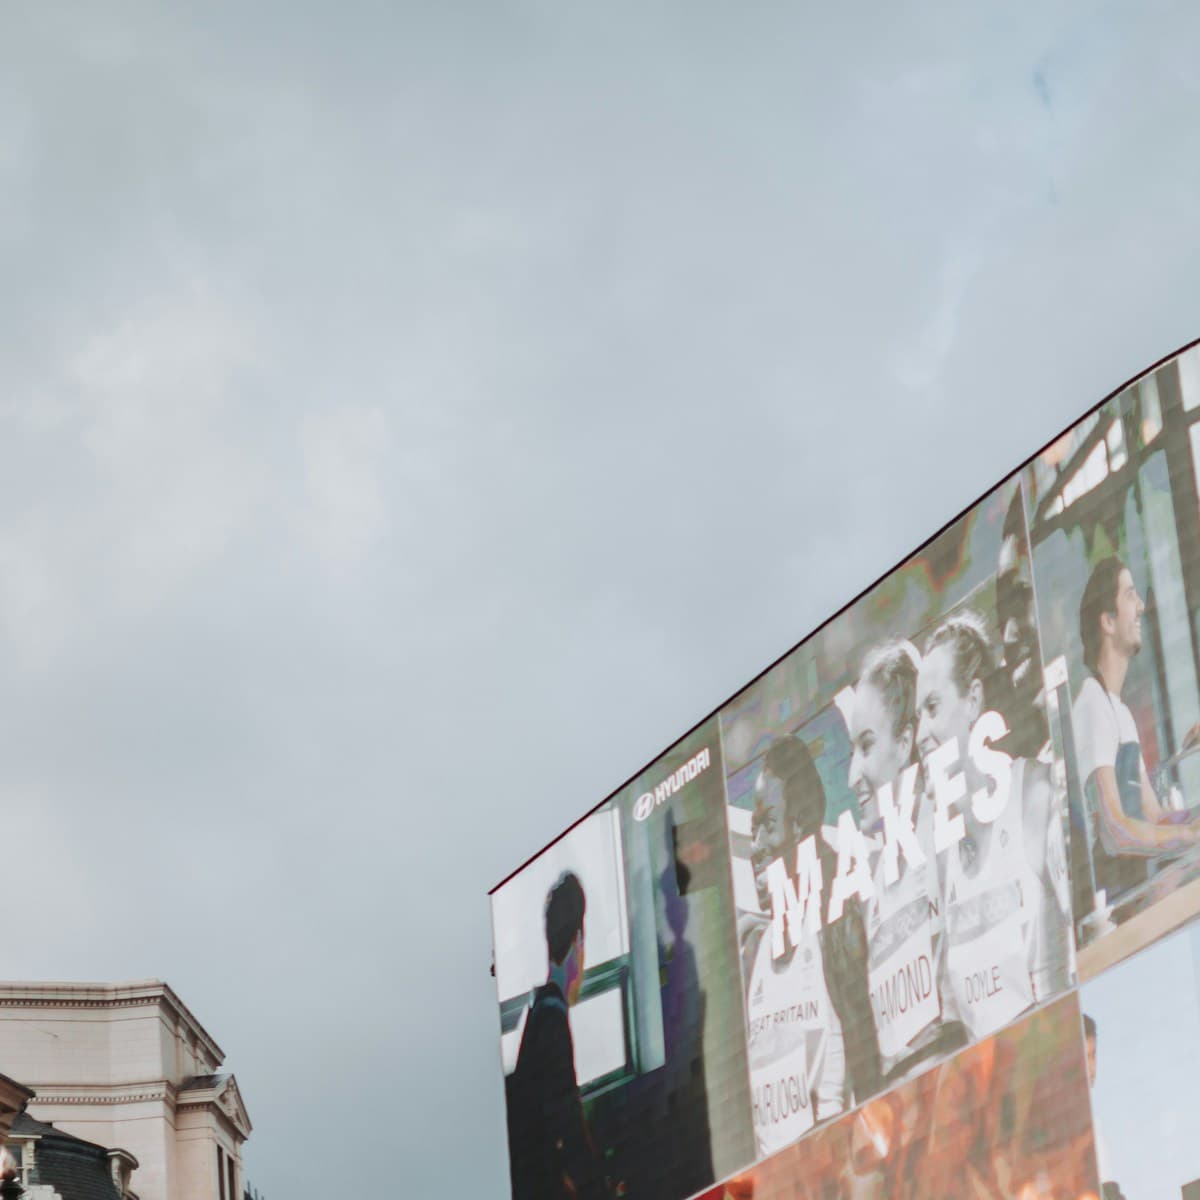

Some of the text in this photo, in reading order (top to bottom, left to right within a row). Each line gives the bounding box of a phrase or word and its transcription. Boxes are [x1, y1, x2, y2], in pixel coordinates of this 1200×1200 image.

[655, 747, 710, 805] HYUNDAI
[766, 710, 1014, 960] MAKES
[964, 965, 1002, 1006] DOYLE
[773, 999, 819, 1027] BRITAIN
